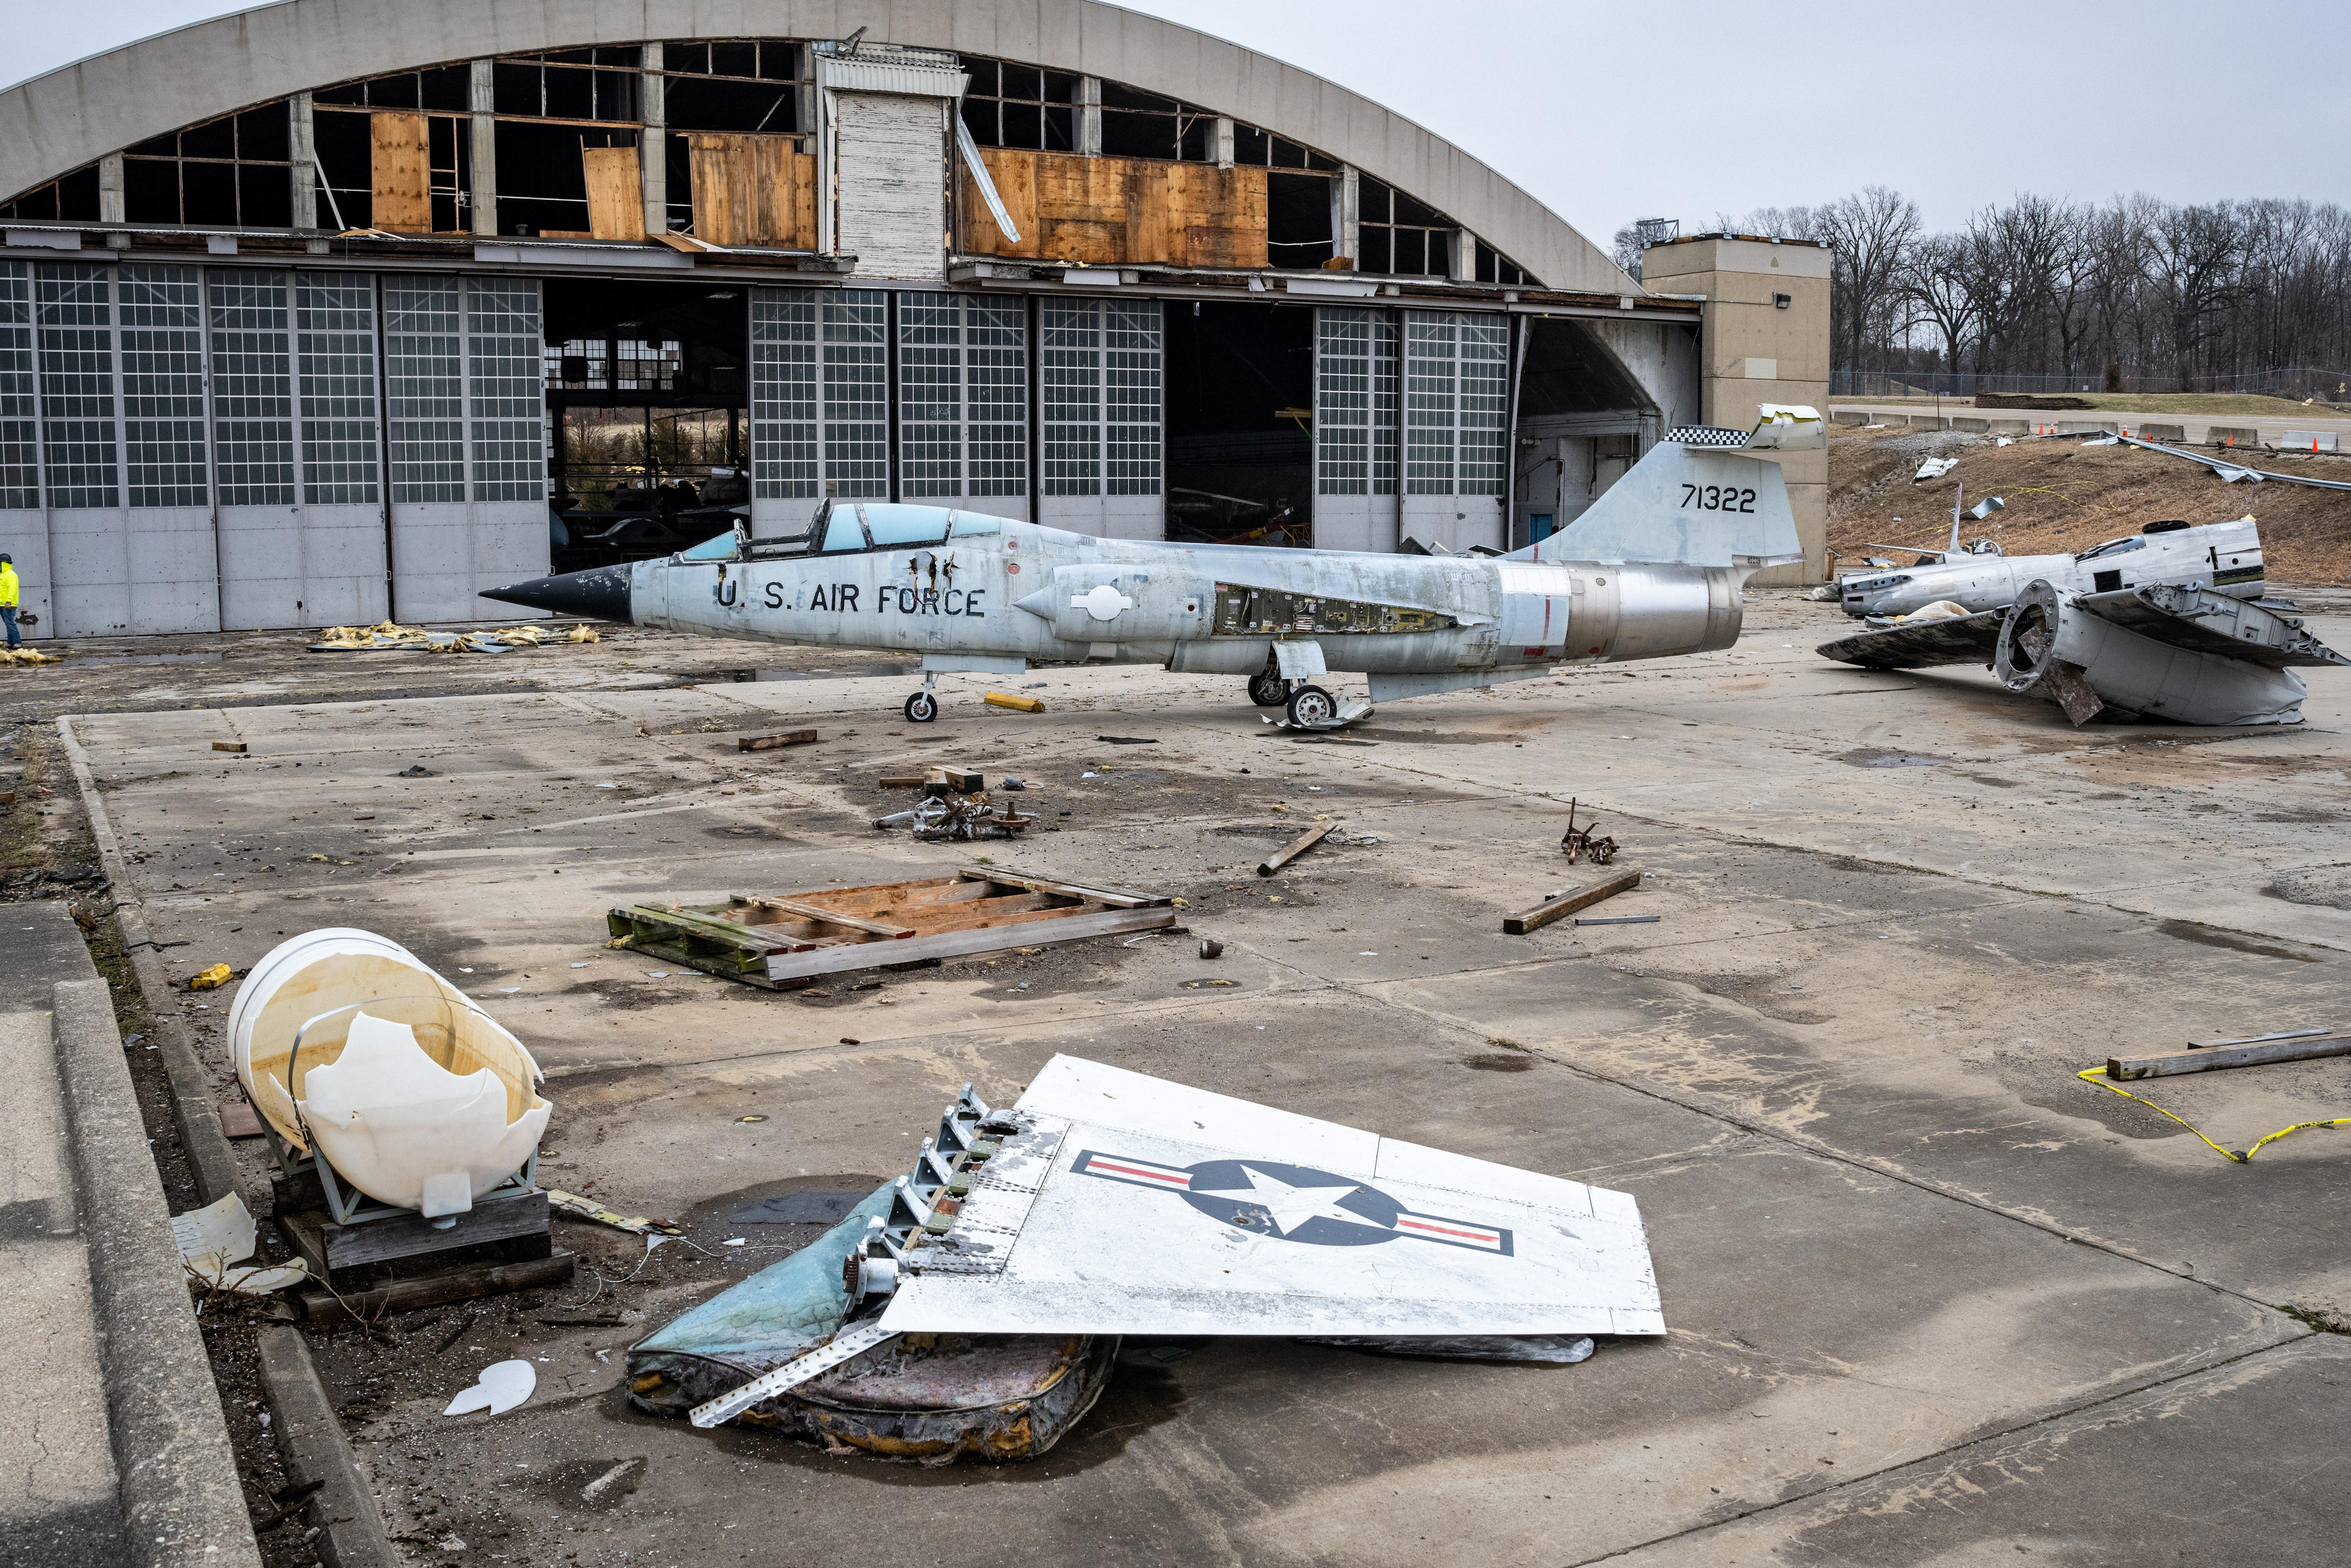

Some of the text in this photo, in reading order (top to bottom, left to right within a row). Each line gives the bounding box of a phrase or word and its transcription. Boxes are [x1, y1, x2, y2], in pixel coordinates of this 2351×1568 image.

[1681, 484, 1756, 514] 71322
[764, 581, 791, 609] S.
[810, 583, 860, 612] AIR
[878, 585, 985, 618] FORCE
